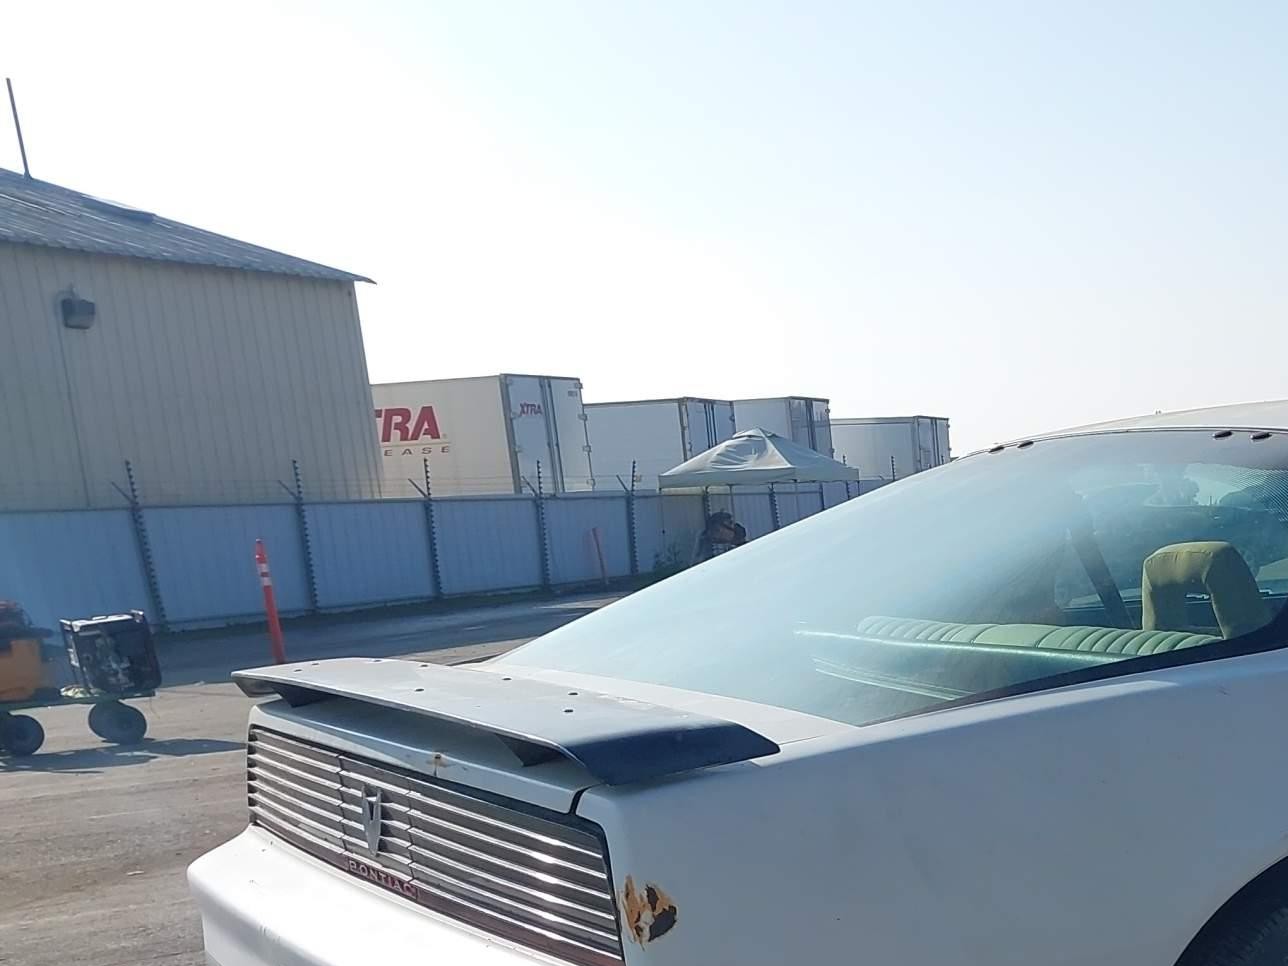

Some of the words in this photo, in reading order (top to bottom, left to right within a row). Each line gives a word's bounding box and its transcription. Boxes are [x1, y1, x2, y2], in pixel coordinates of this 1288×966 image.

[375, 406, 440, 442] RA
[520, 402, 544, 416] XTRA
[349, 860, 414, 898] PONTIAC
